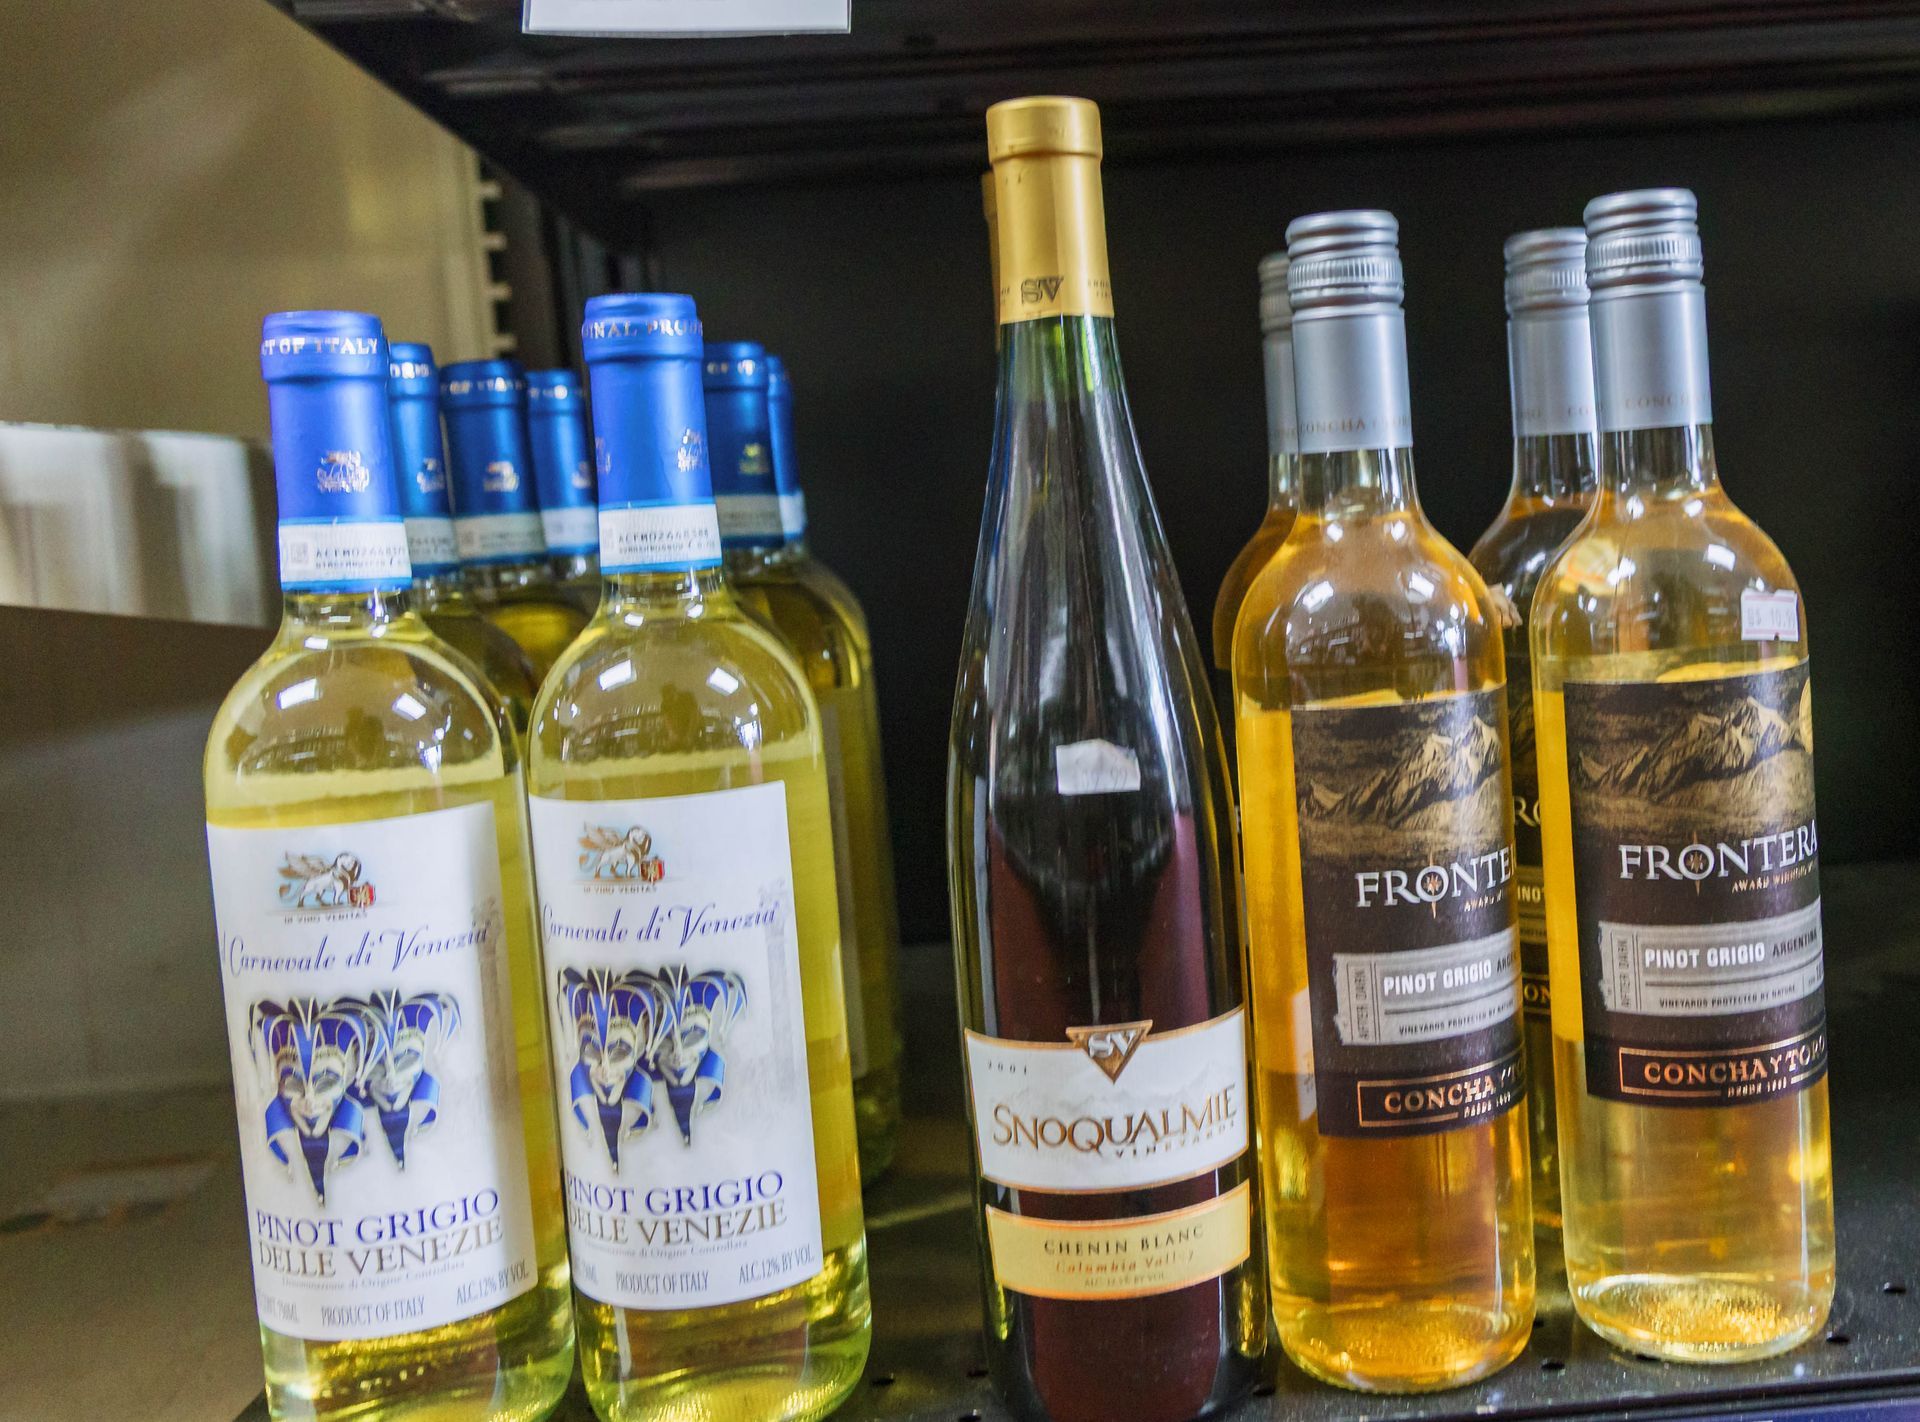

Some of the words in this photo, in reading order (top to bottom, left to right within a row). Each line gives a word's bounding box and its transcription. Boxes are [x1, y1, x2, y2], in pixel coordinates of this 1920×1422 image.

[1020, 275, 1065, 305] SV
[279, 337, 306, 355] OF
[314, 336, 378, 355] ITALY
[1617, 818, 1819, 881] FRONTERA
[636, 904, 664, 944] di
[666, 900, 780, 948] Venezia
[222, 930, 337, 978] Carnevale
[345, 931, 376, 969] di
[378, 919, 491, 972] Venezia
[1644, 947, 1701, 969] PINOT
[1706, 941, 1766, 967] GRIGIO
[1383, 971, 1437, 998] PINOT
[1442, 958, 1492, 989] GRIGIO
[1659, 998, 1708, 1009] VINEYARDS
[1711, 993, 1758, 1008] PROTECTED
[1760, 991, 1769, 1000] BY
[1771, 984, 1796, 999] NATURE
[1087, 1029, 1135, 1058] SV
[1398, 1022, 1445, 1036] VINEYARDS
[1644, 1058, 1768, 1085] CONCHA
[1769, 1054, 1782, 1074] Y
[1384, 1074, 1496, 1114] CONCHA
[992, 1084, 1237, 1156] SNOQUALMIE
[566, 1169, 635, 1214] PINOT
[644, 1169, 784, 1216] GRIGIO
[256, 1208, 342, 1247] PINOT
[355, 1187, 500, 1240] GRIGIO
[569, 1201, 629, 1244] DELLE
[636, 1199, 788, 1246] VENEZIE
[257, 1239, 336, 1278] DELLE
[346, 1219, 504, 1276] VENEZIE
[1043, 1238, 1129, 1257] CHENIN
[1140, 1223, 1205, 1251] BLANC
[498, 1265, 510, 1289] BY
[781, 1249, 793, 1273] BY
[1055, 1260, 1137, 1275] Columbia
[1145, 1250, 1195, 1268] Vally
[616, 1272, 660, 1294] PRODUCT
[662, 1273, 677, 1293] OF
[679, 1270, 710, 1293] ITALY
[321, 1303, 373, 1328] PRODUCT
[375, 1302, 393, 1324] OF
[394, 1295, 426, 1322] ITALY
